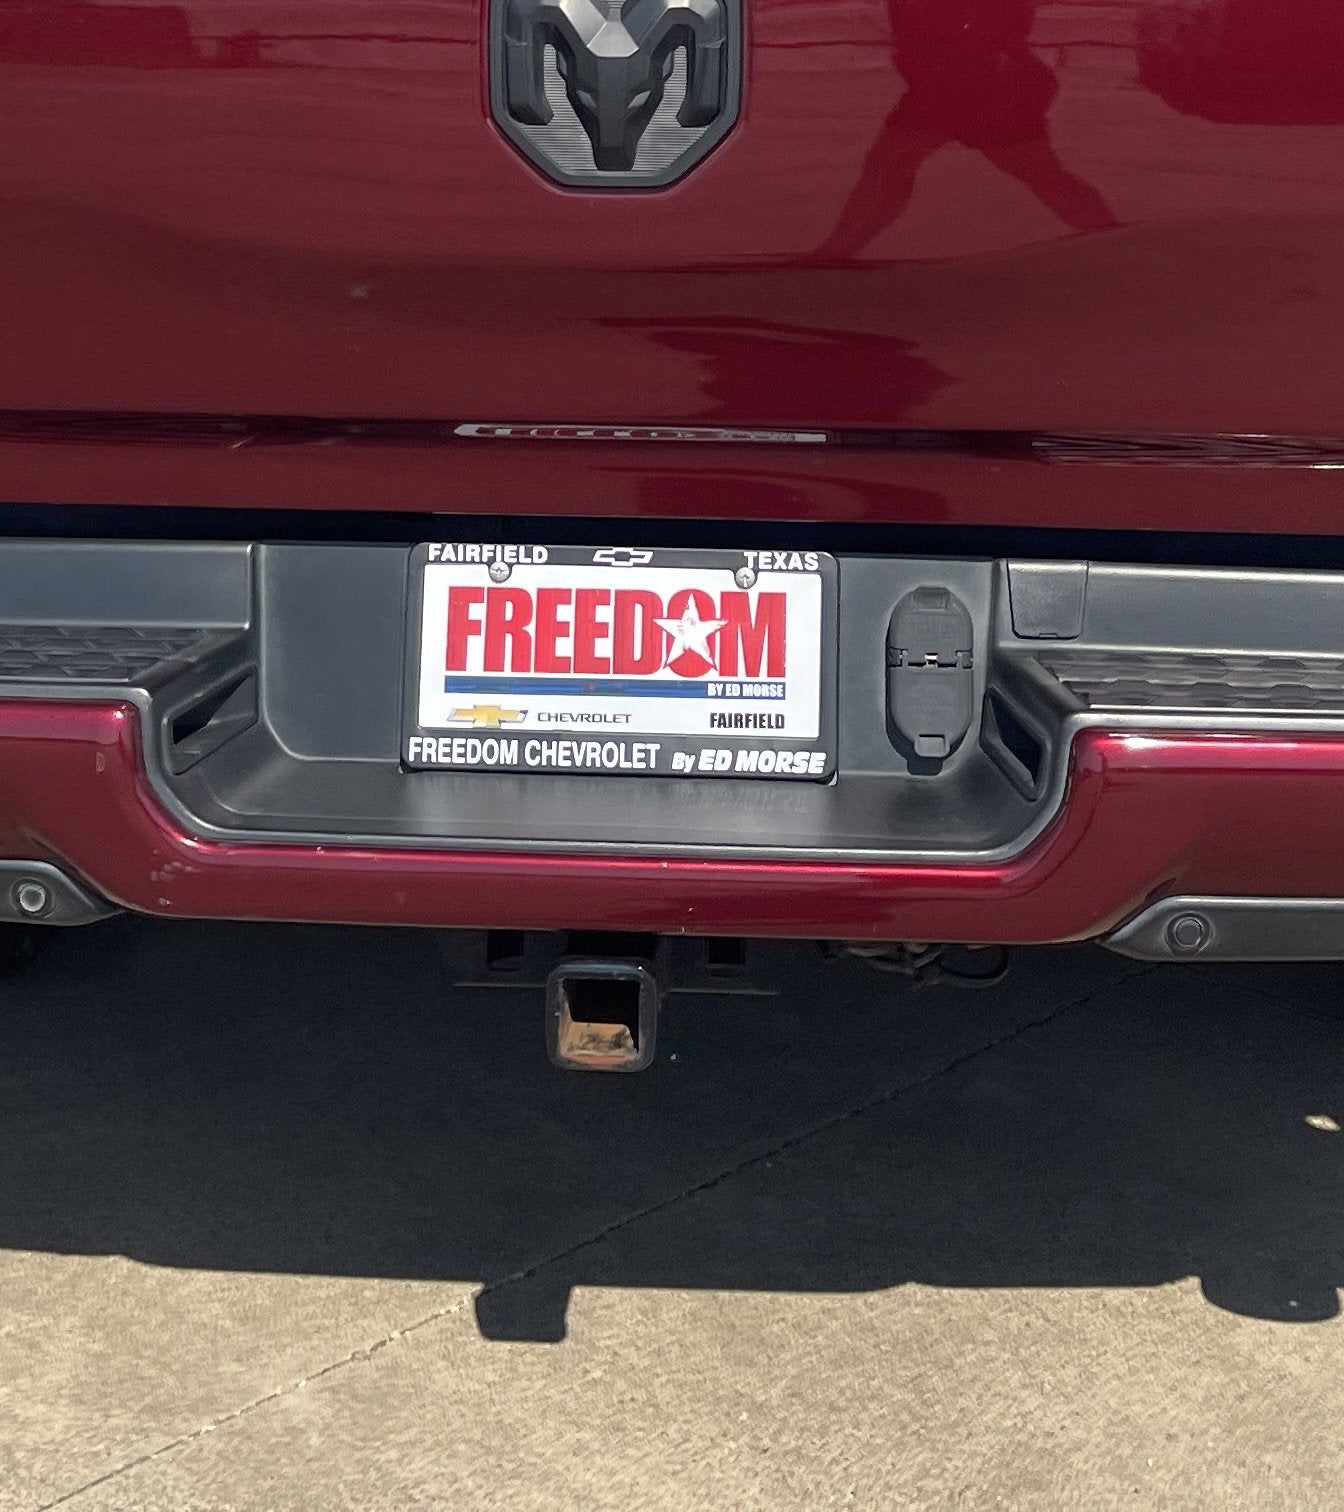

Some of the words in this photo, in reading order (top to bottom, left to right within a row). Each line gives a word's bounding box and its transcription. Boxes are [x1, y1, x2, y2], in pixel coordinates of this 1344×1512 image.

[428, 544, 549, 564] FAIRFIELD
[744, 551, 819, 571] TEXAS
[445, 586, 788, 678] FREEDOM
[707, 683, 724, 696] BY
[725, 683, 741, 696] ED
[742, 684, 784, 697] MORSE
[537, 712, 632, 724] CHEVROLET
[709, 712, 785, 729] FAIRFIELD
[408, 736, 518, 766] FREEDOM
[524, 739, 661, 769] CHEVROLET
[671, 751, 697, 773] By
[698, 749, 733, 771] ED
[734, 750, 827, 774] MORSE
